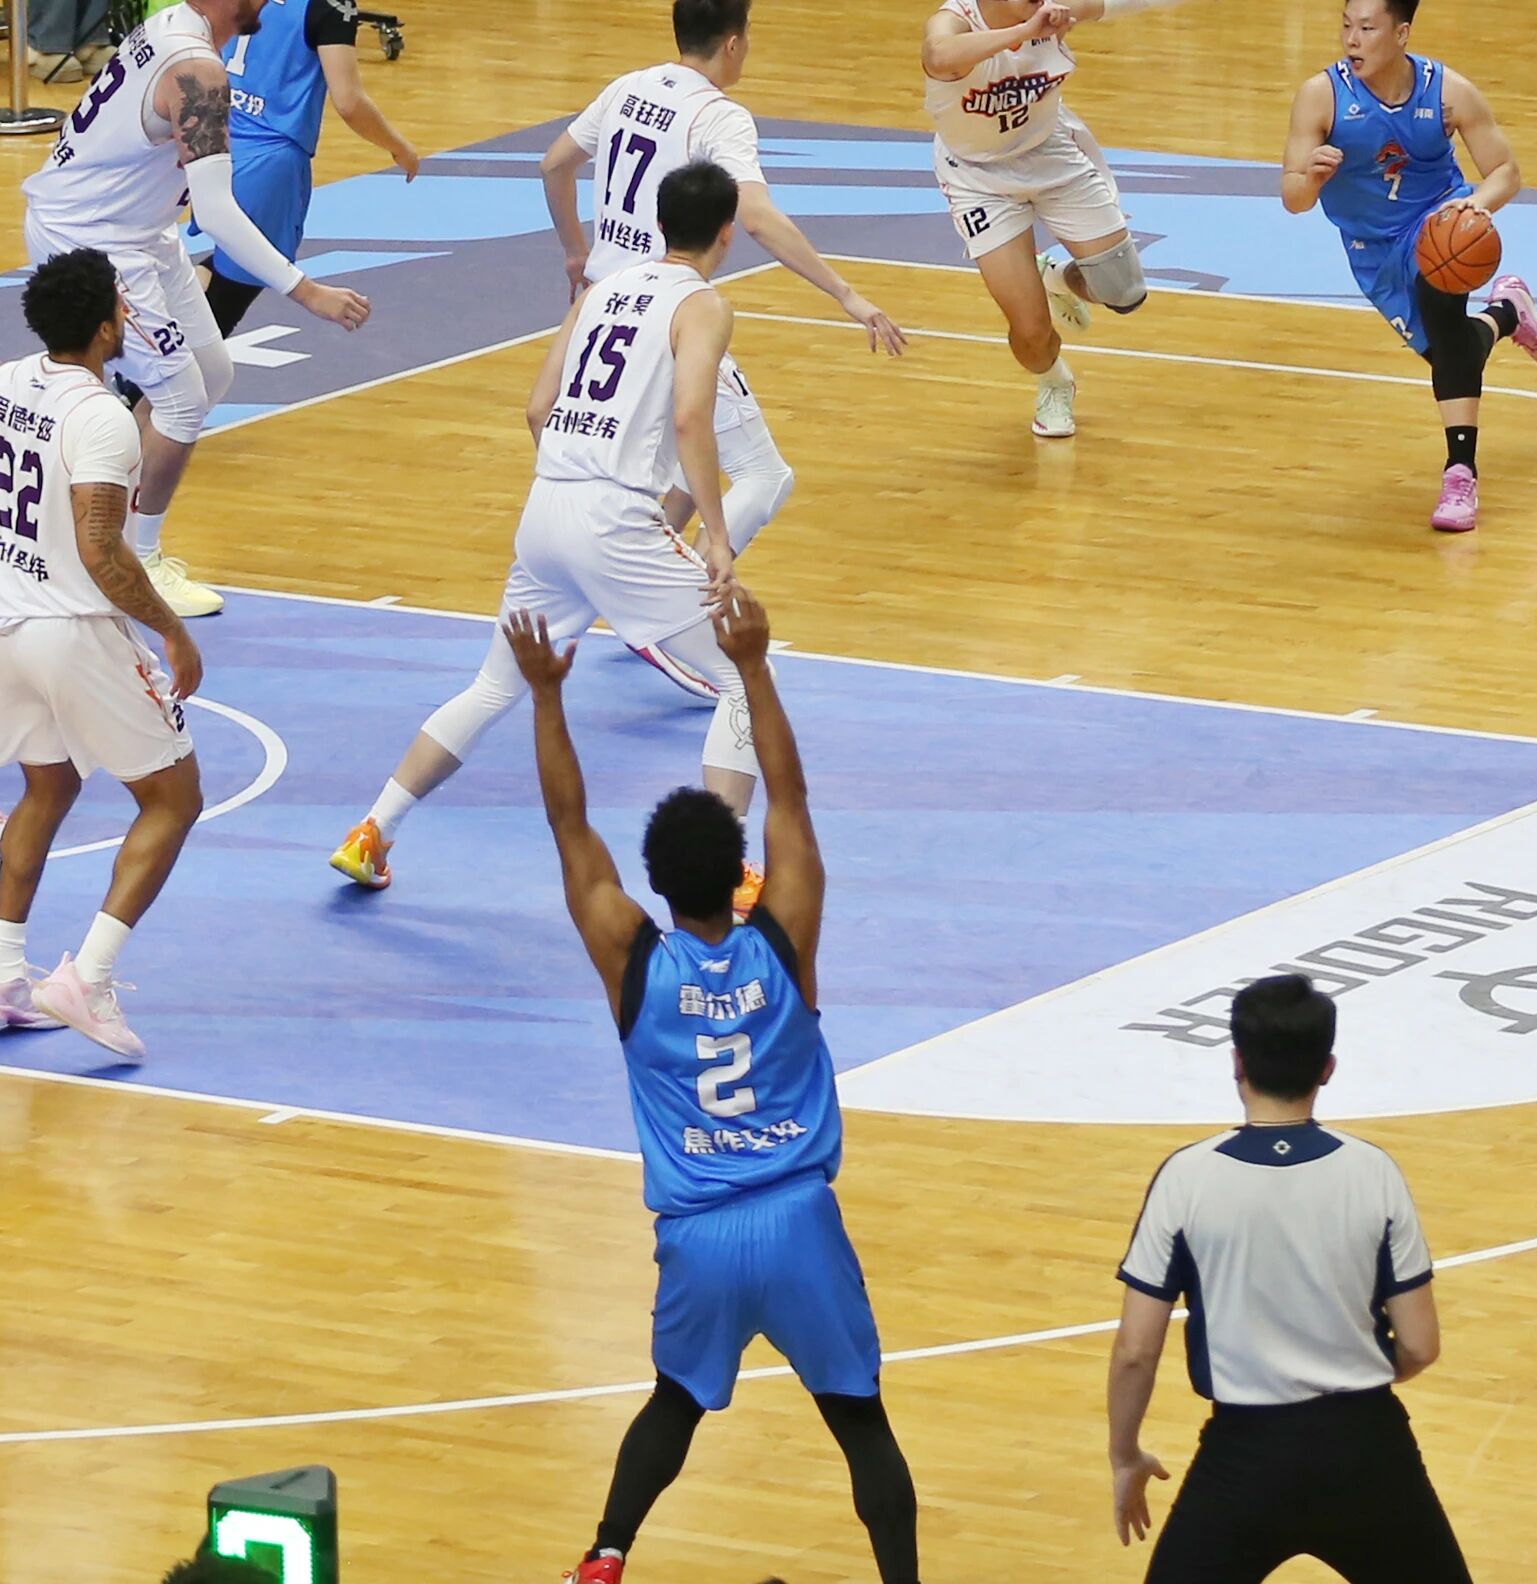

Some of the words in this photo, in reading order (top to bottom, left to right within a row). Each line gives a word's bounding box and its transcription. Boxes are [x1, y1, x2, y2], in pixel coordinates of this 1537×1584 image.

[998, 105, 1029, 133] 12
[604, 127, 657, 215] 17
[1383, 173, 1402, 201] 7
[600, 216, 653, 255] 州经纬
[963, 207, 991, 238] 12
[567, 324, 639, 402] 15
[695, 1032, 757, 1118] 2
